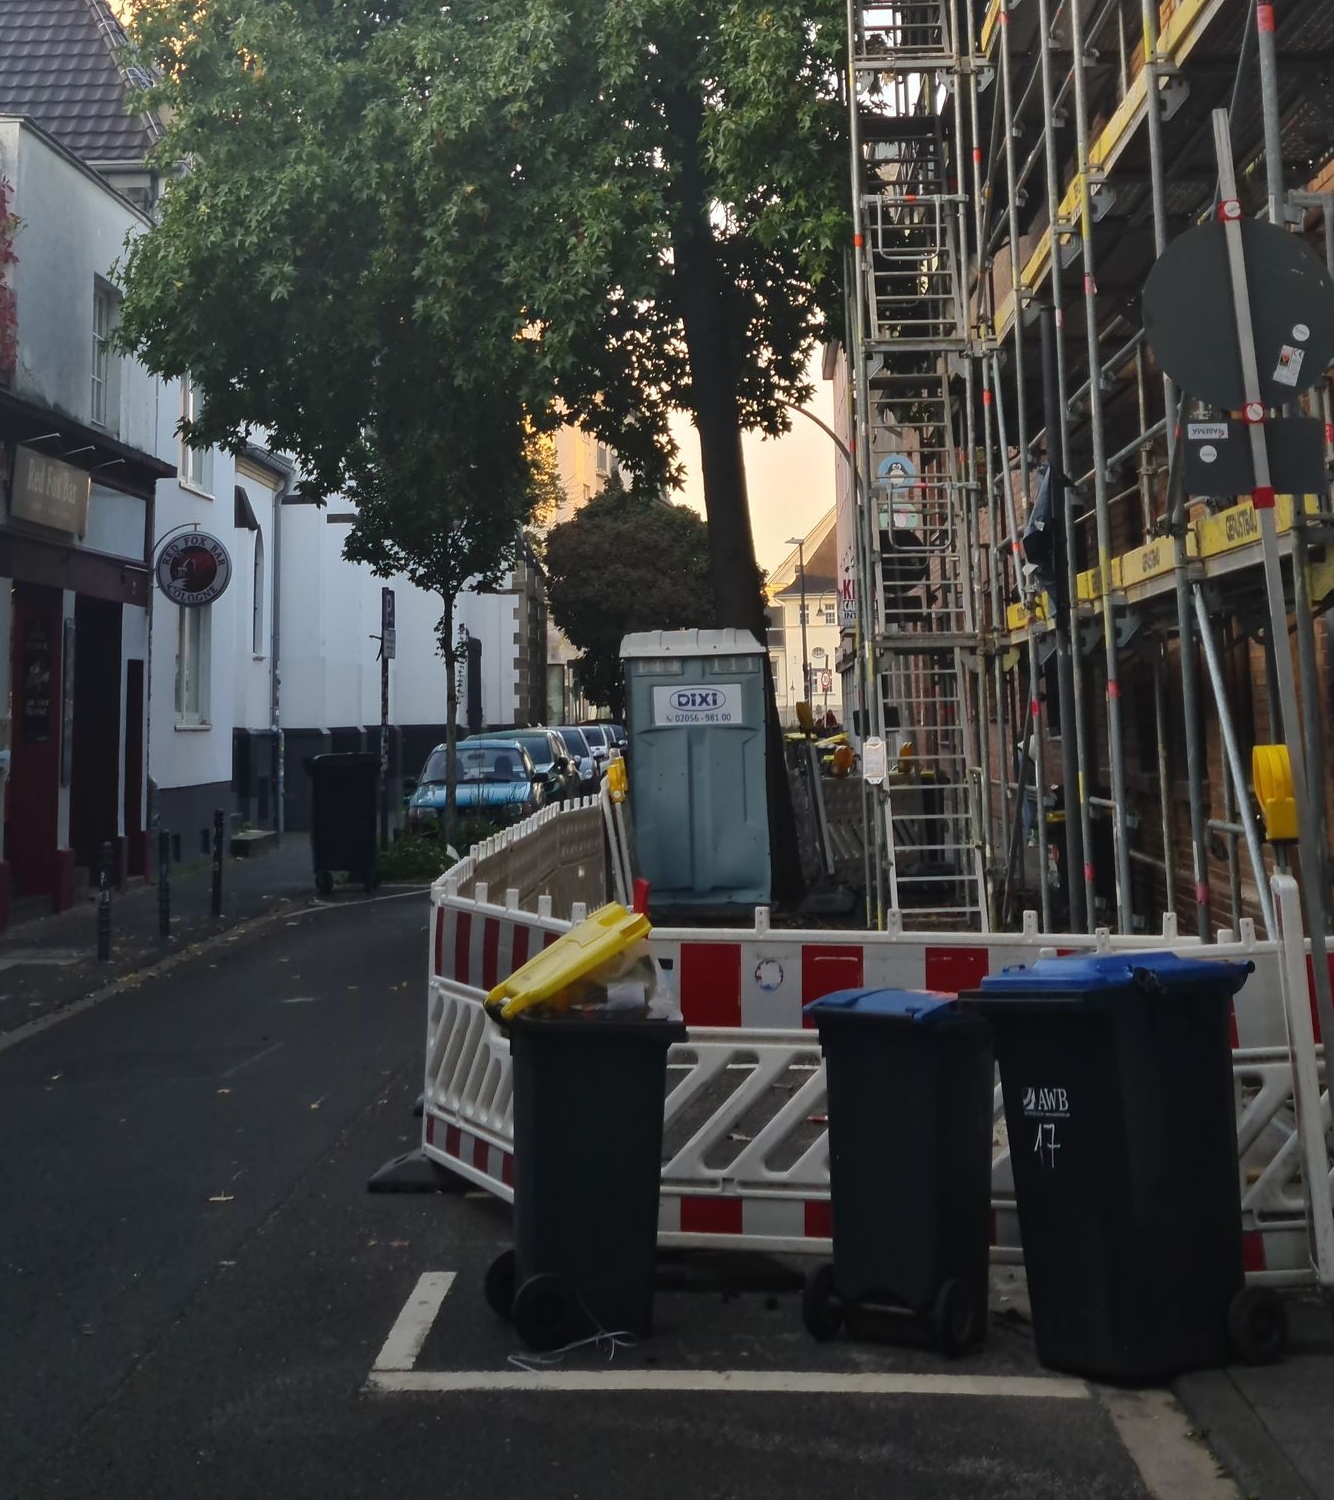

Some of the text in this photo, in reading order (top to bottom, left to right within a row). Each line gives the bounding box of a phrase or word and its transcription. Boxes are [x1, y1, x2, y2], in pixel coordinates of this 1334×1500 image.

[27, 458, 46, 494] Red
[62, 472, 78, 505] Bar
[162, 536, 226, 566] RED FOX BAR
[167, 584, 219, 601] COLOGNE
[677, 692, 718, 707] DIXI
[675, 713, 699, 723] 02056
[705, 713, 719, 722] 981
[721, 712, 732, 721] 00
[1038, 1087, 1069, 1111] AWB
